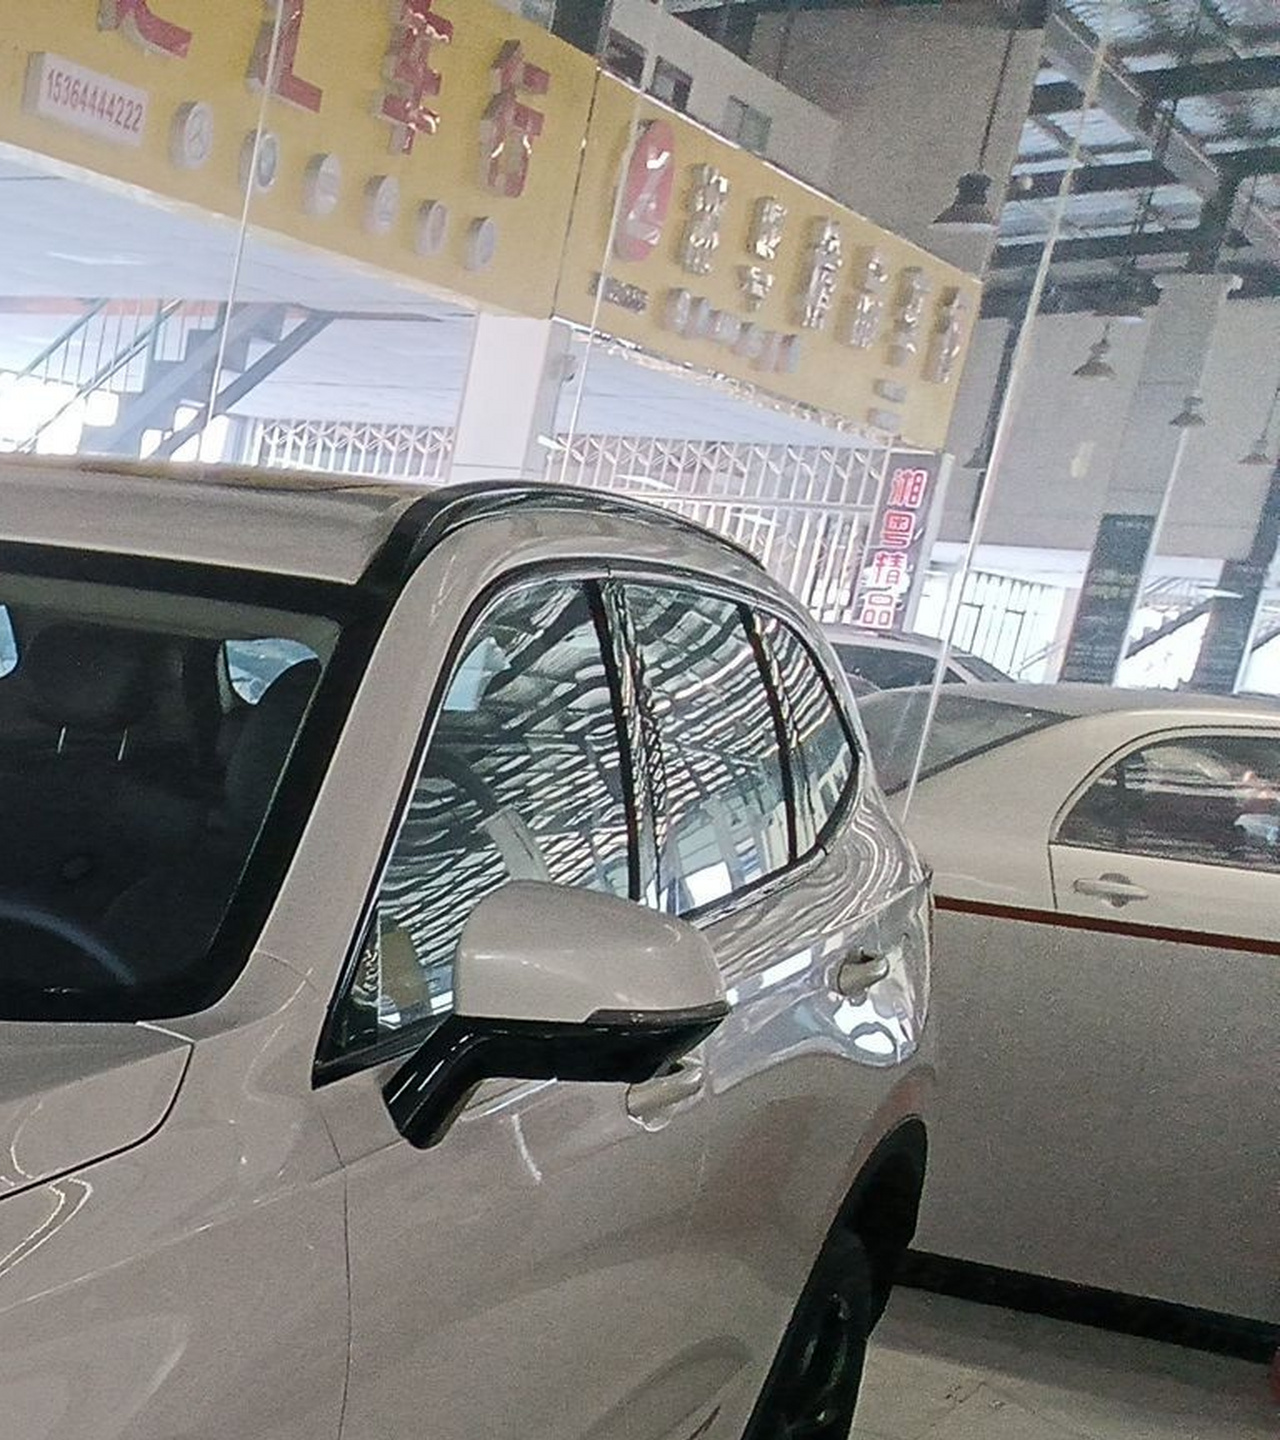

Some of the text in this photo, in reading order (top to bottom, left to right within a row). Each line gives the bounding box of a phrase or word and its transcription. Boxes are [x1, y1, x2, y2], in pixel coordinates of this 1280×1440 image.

[47, 69, 143, 132] 15364444222
[860, 469, 927, 629] 湘粤精品
